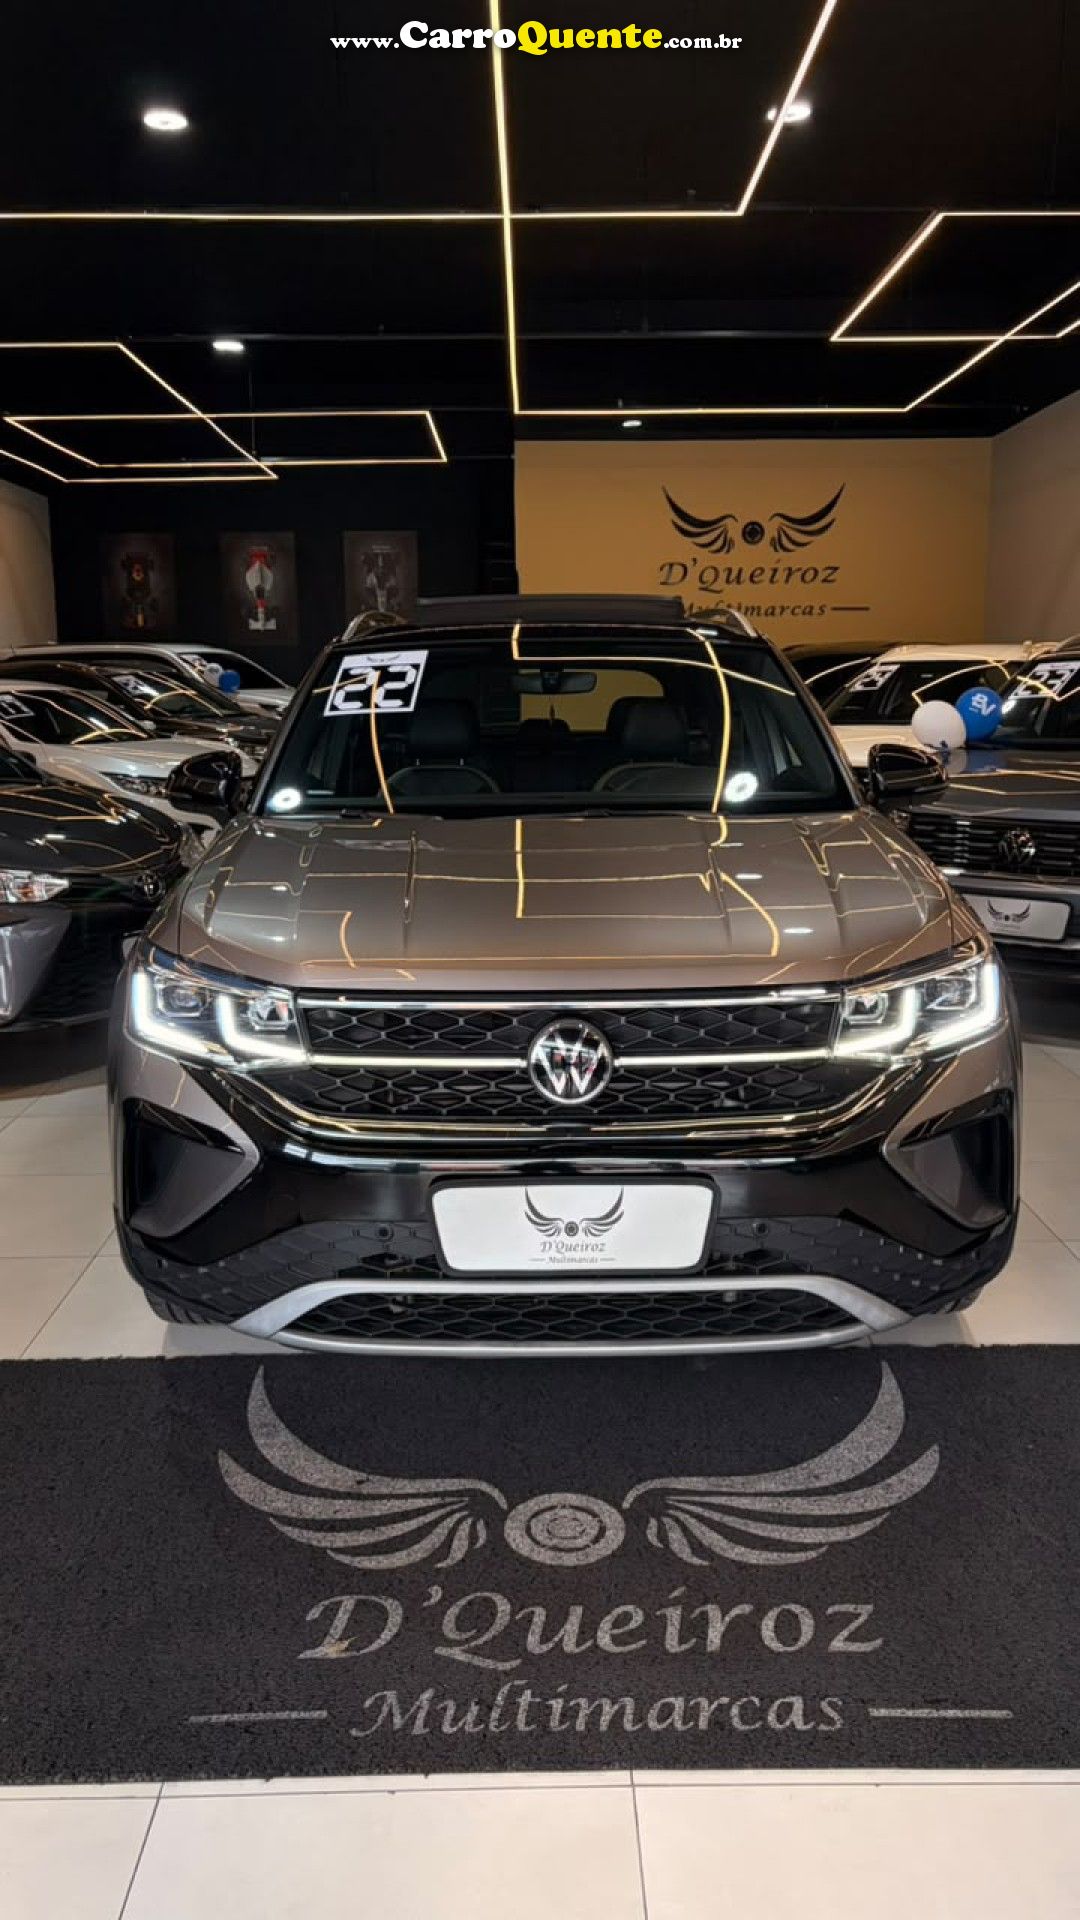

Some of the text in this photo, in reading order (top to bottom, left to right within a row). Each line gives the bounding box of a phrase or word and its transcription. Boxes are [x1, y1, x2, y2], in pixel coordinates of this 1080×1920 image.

[659, 557, 840, 594] D'Queiroz
[684, 600, 827, 617] imarcas
[333, 665, 417, 710] 22
[540, 1240, 606, 1254] D'Queiroz
[297, 1585, 883, 1670] D'Queiroz
[351, 1680, 844, 1737] Multimarcas
